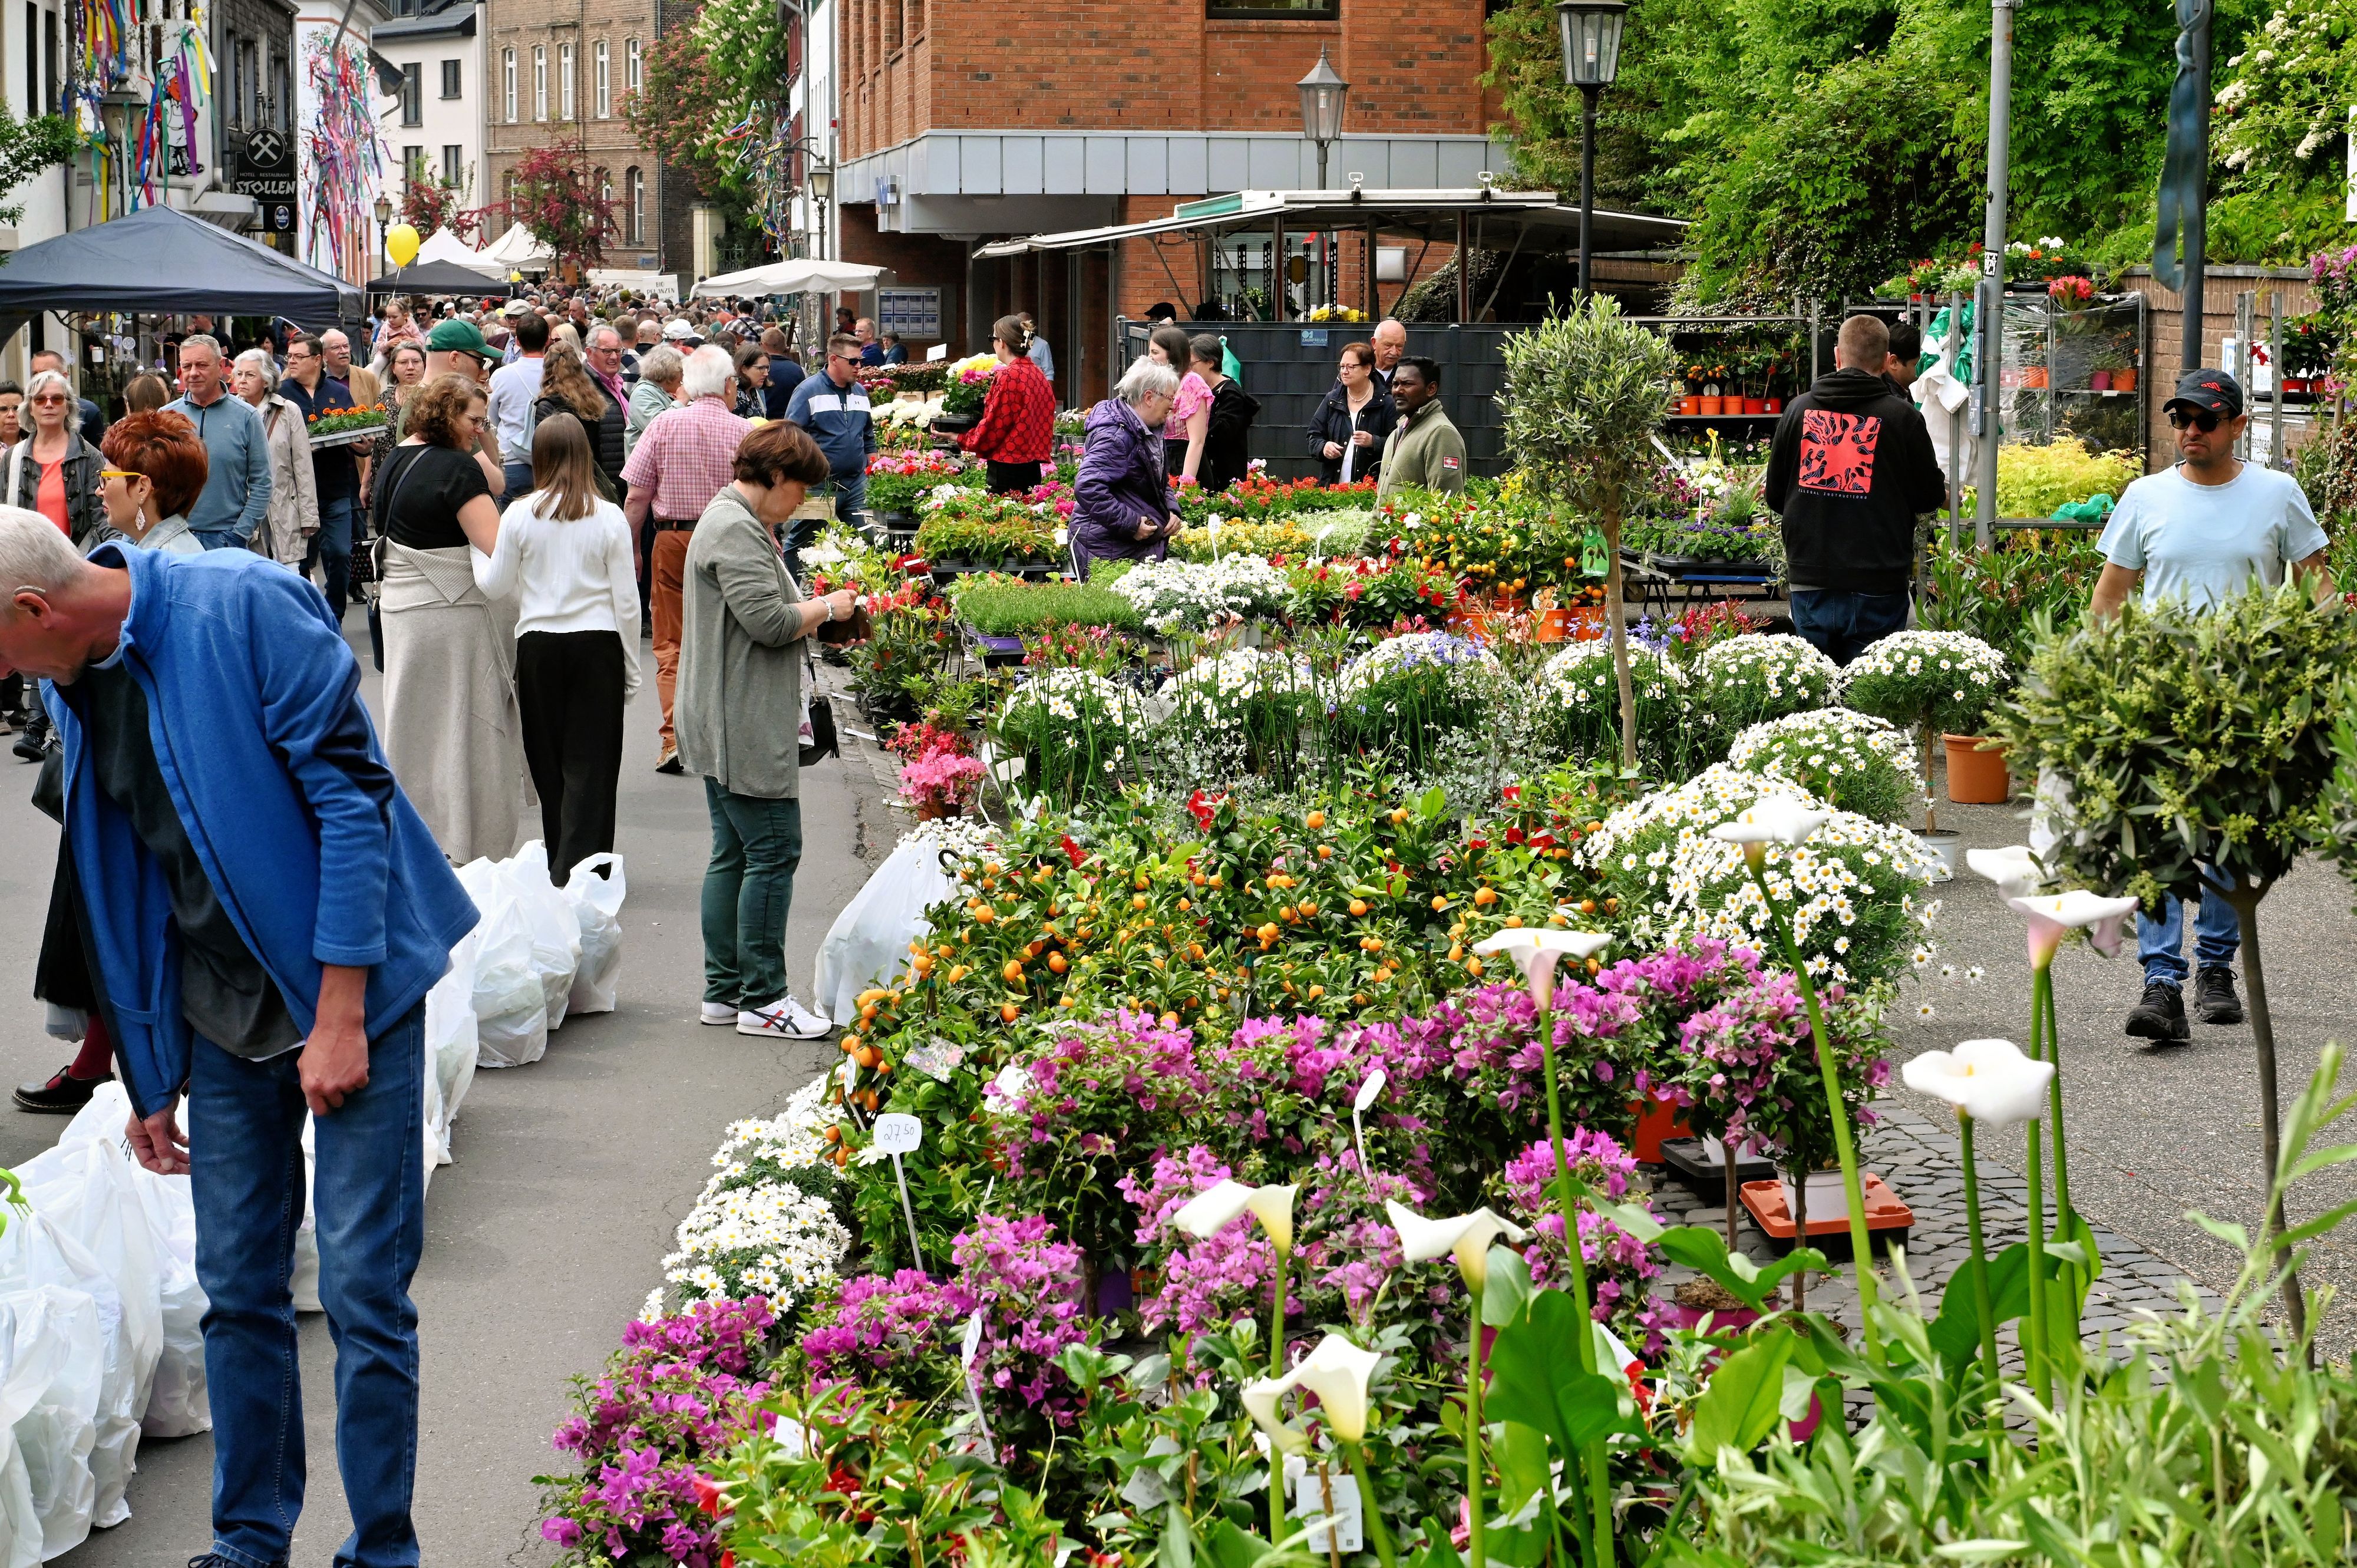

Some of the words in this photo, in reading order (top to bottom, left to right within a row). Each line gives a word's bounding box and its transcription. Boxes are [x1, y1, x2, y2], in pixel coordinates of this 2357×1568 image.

[236, 180, 296, 194] STOLLEN
[2260, 373, 2272, 387] Ban
[2252, 435, 2272, 450] eschrän
[884, 1124, 915, 1144] 27,50
